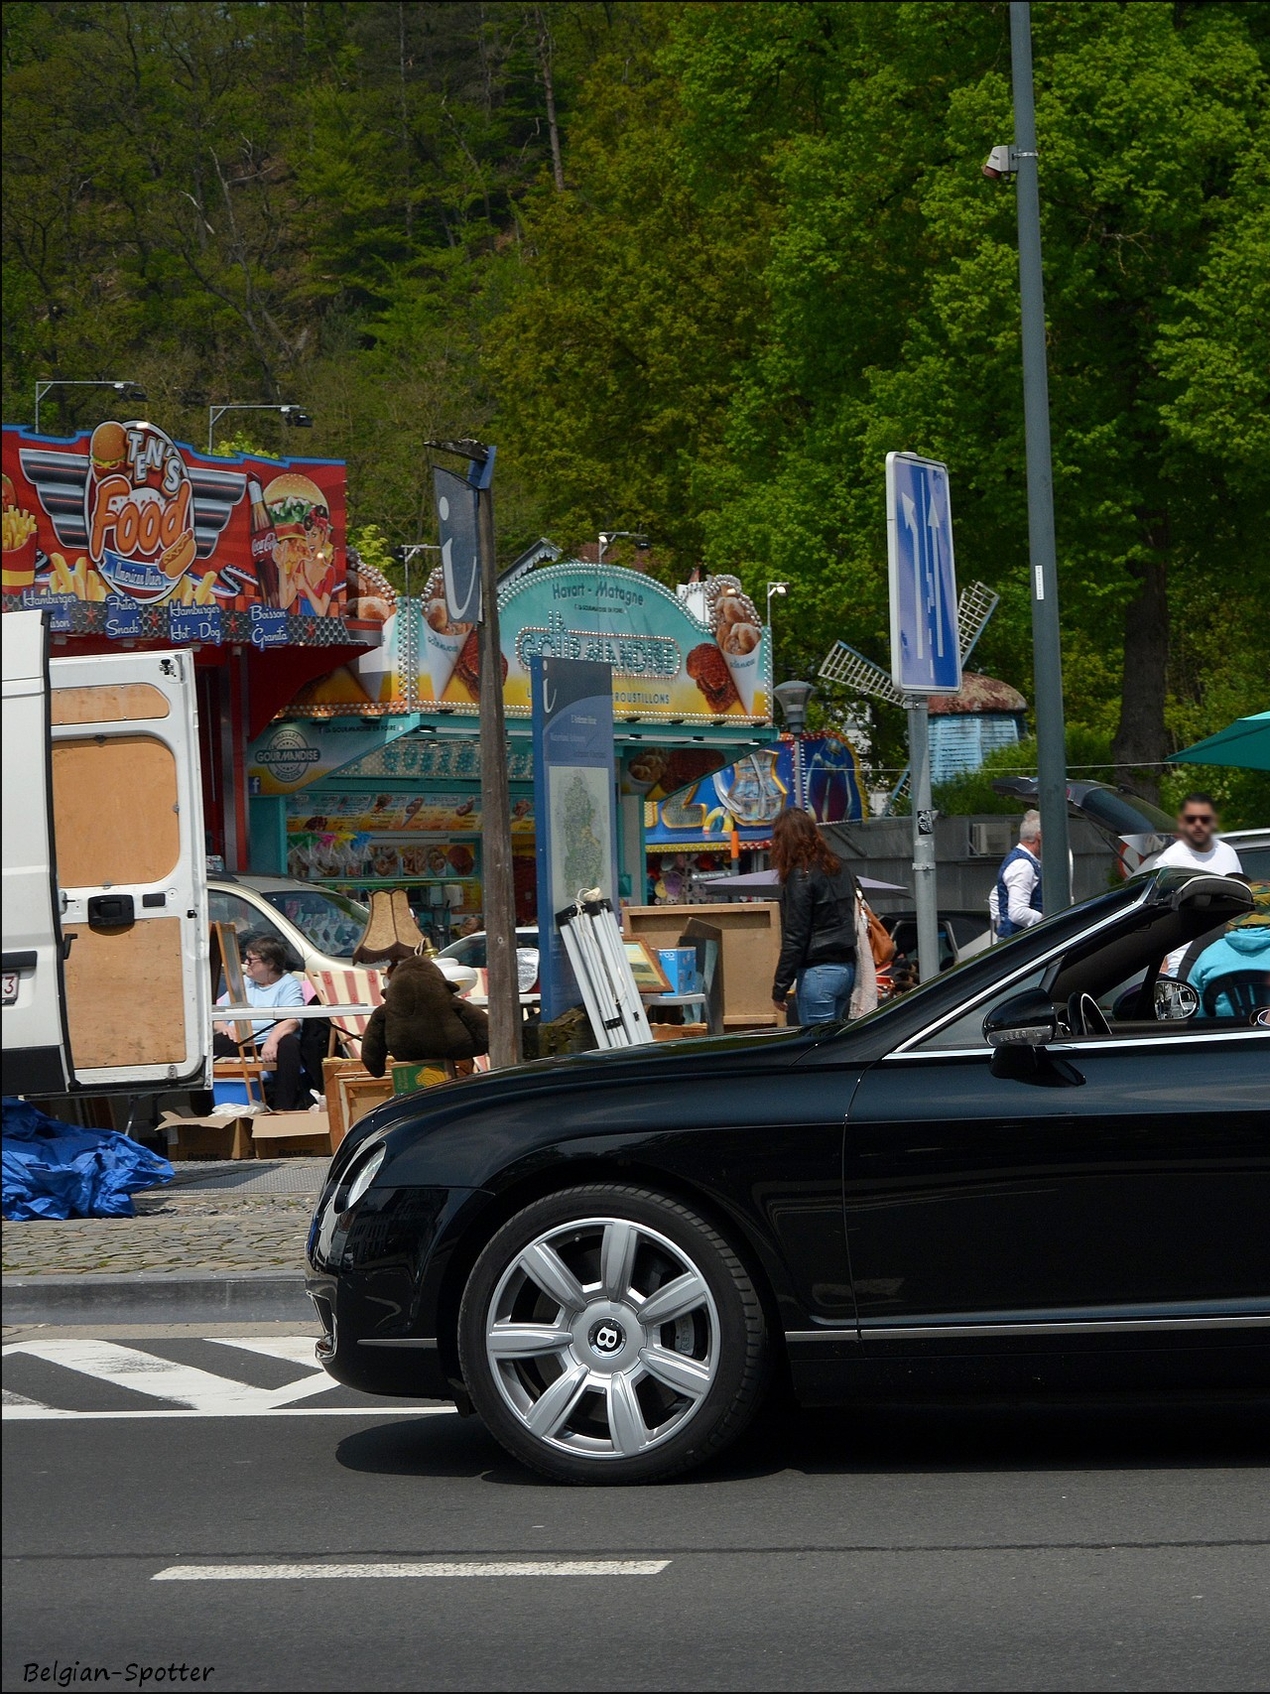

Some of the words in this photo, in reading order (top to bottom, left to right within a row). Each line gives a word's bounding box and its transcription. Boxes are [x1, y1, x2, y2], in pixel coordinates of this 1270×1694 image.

[90, 475, 192, 562] Food
[23, 589, 77, 610] Hamburger
[107, 594, 138, 611] Frites
[552, 583, 585, 600] Havart
[596, 581, 643, 605] Matagne
[169, 600, 221, 621] Hamburger
[250, 605, 286, 621] Boisson
[105, 619, 140, 636] Snack
[171, 624, 190, 641] Hot
[198, 622, 221, 643] Dog
[548, 610, 567, 635] LA
[251, 625, 288, 648] Granita
[519, 632, 675, 675] GOURMANDISE
[612, 691, 669, 705] ROUSTILLONS
[256, 750, 319, 762] GOURMANDISE
